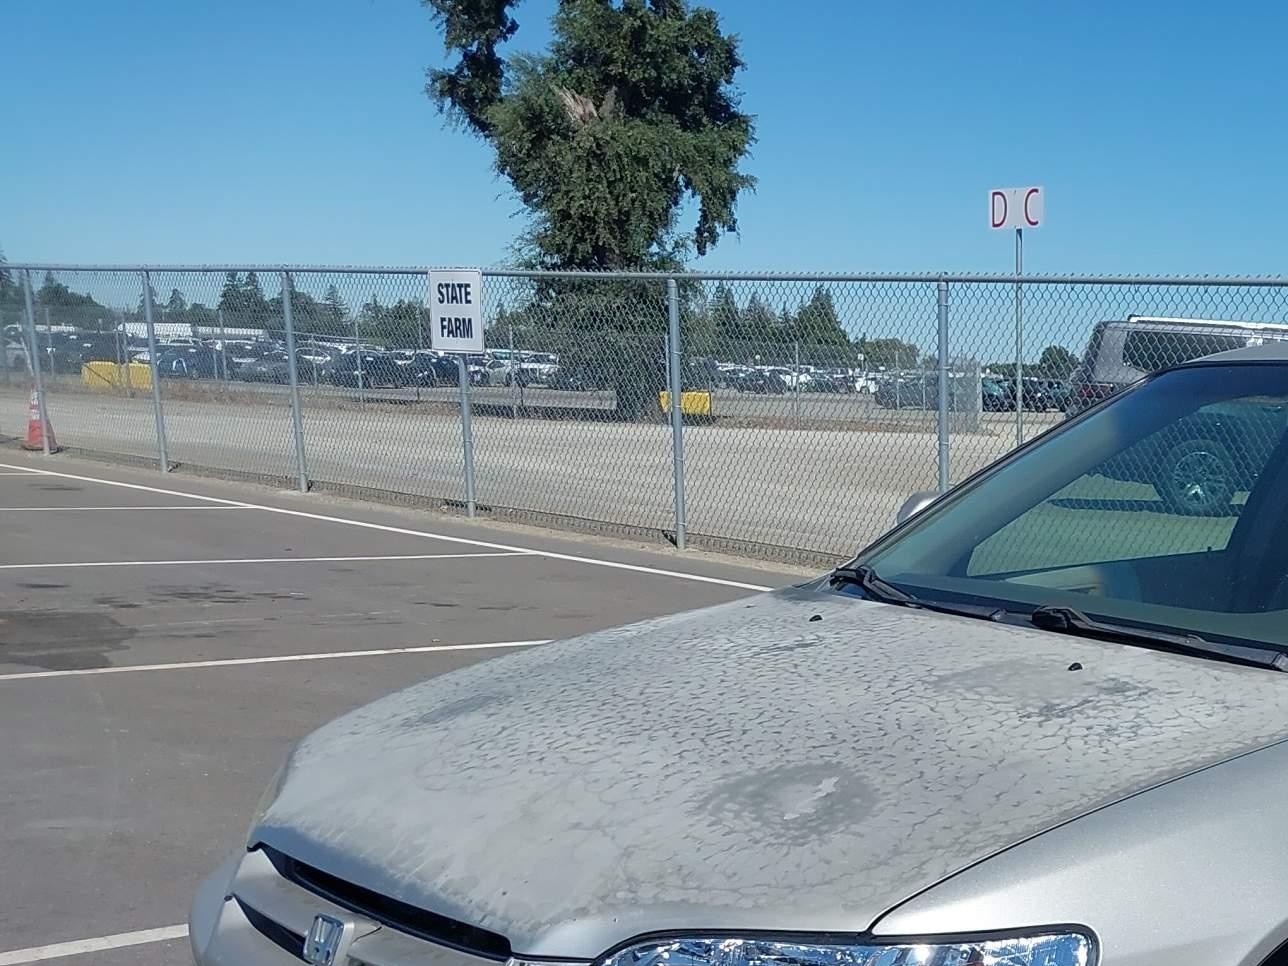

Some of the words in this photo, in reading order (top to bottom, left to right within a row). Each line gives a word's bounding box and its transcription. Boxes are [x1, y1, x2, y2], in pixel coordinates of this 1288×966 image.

[992, 191, 1007, 228] D
[1024, 188, 1039, 226] C
[437, 283, 472, 304] STATE
[440, 317, 473, 339] FARM
